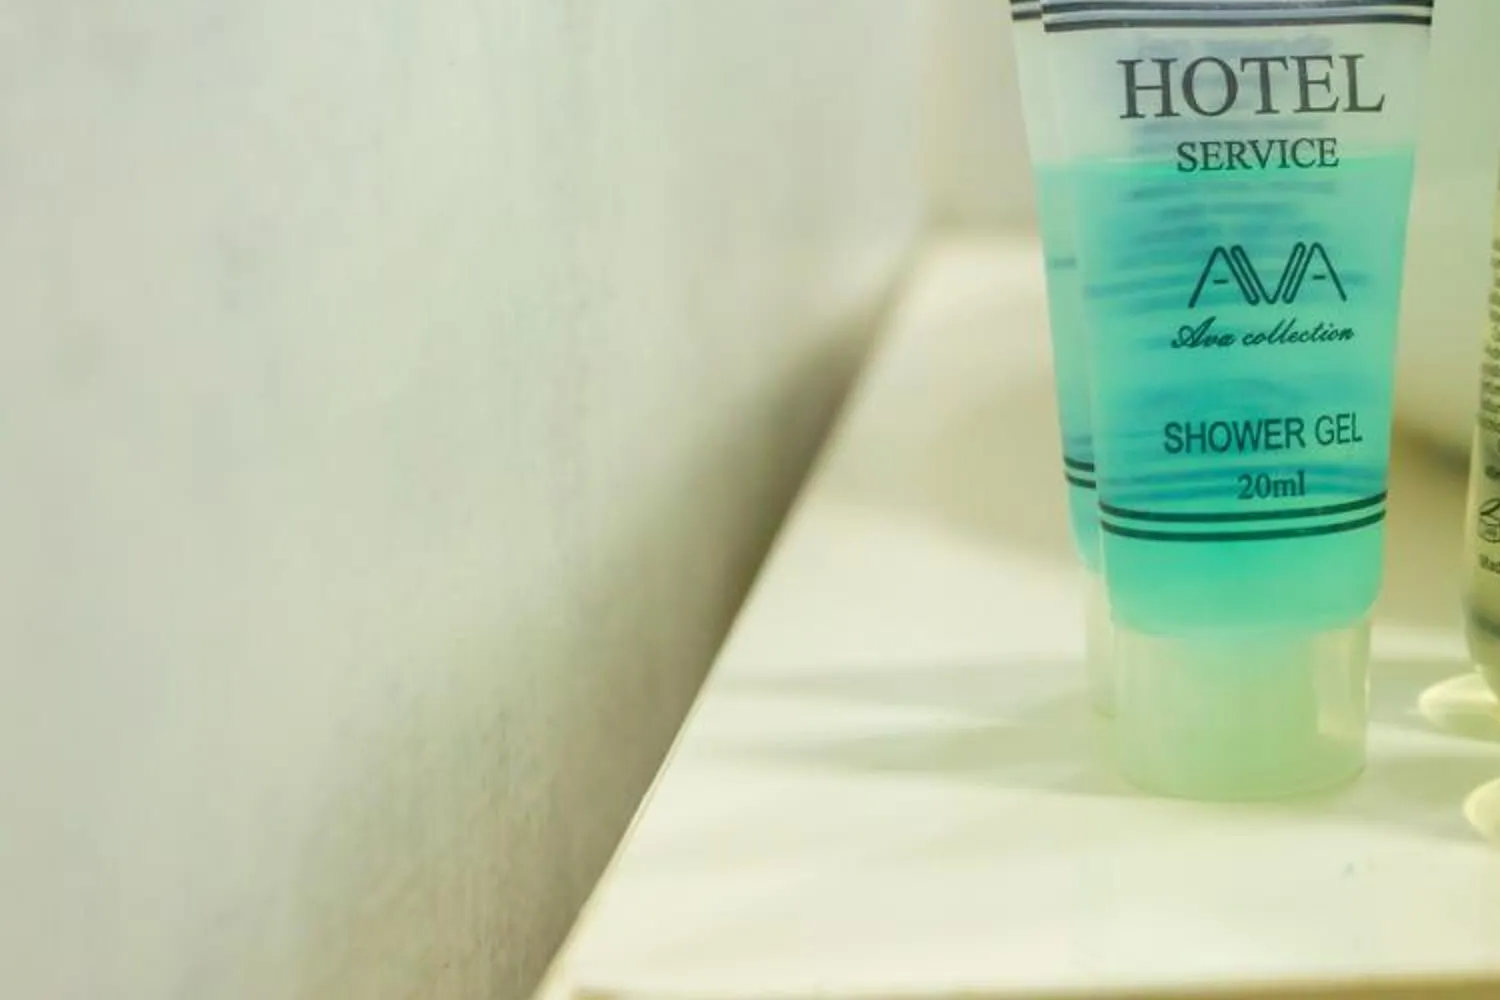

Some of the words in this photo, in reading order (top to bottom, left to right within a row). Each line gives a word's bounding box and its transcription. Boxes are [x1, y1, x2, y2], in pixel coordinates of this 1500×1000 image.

[1117, 54, 1386, 120] HOTEL
[1176, 137, 1340, 173] SERVICE
[1187, 241, 1349, 308] AVA
[1171, 316, 1237, 348] Ava
[1242, 317, 1355, 347] collection
[1163, 416, 1306, 454] SHOWER
[1315, 412, 1363, 447] GEL
[1237, 470, 1306, 500] 20ml
